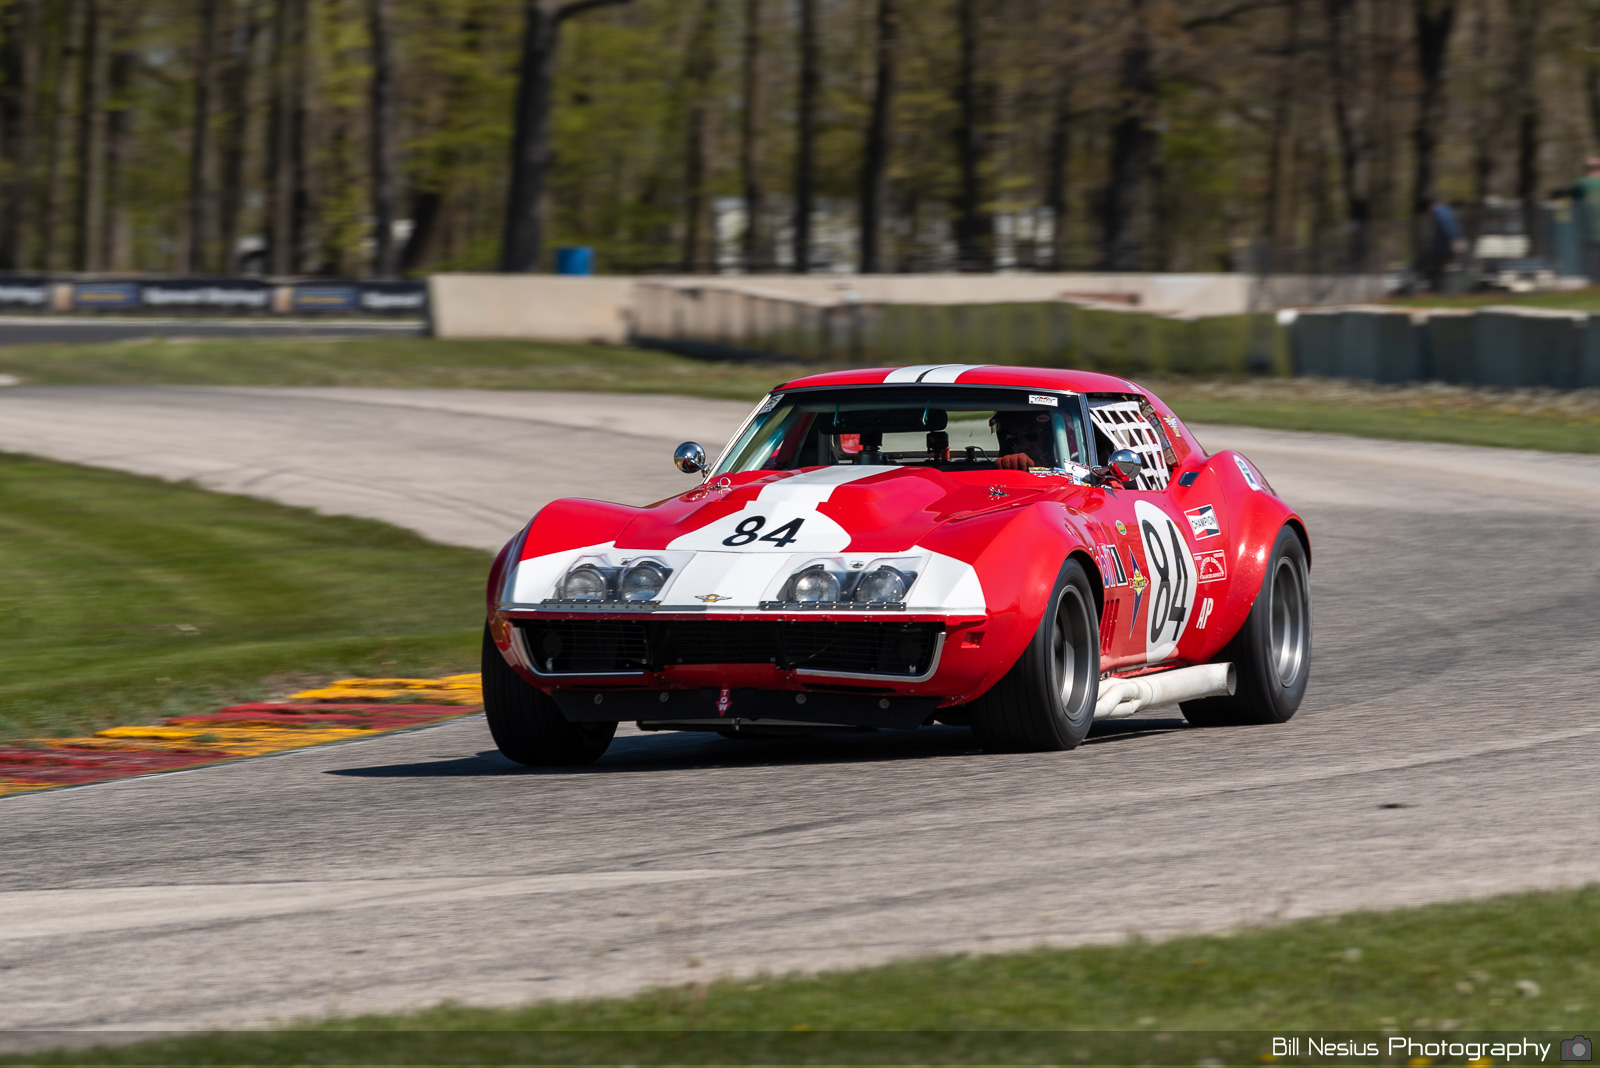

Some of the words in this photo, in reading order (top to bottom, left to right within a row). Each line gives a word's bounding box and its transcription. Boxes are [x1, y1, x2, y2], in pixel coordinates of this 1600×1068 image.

[722, 515, 806, 547] 84
[1191, 514, 1217, 530] CHAMPION
[1141, 519, 1188, 643] 84
[1196, 597, 1214, 630] AP
[718, 689, 729, 711] TOW
